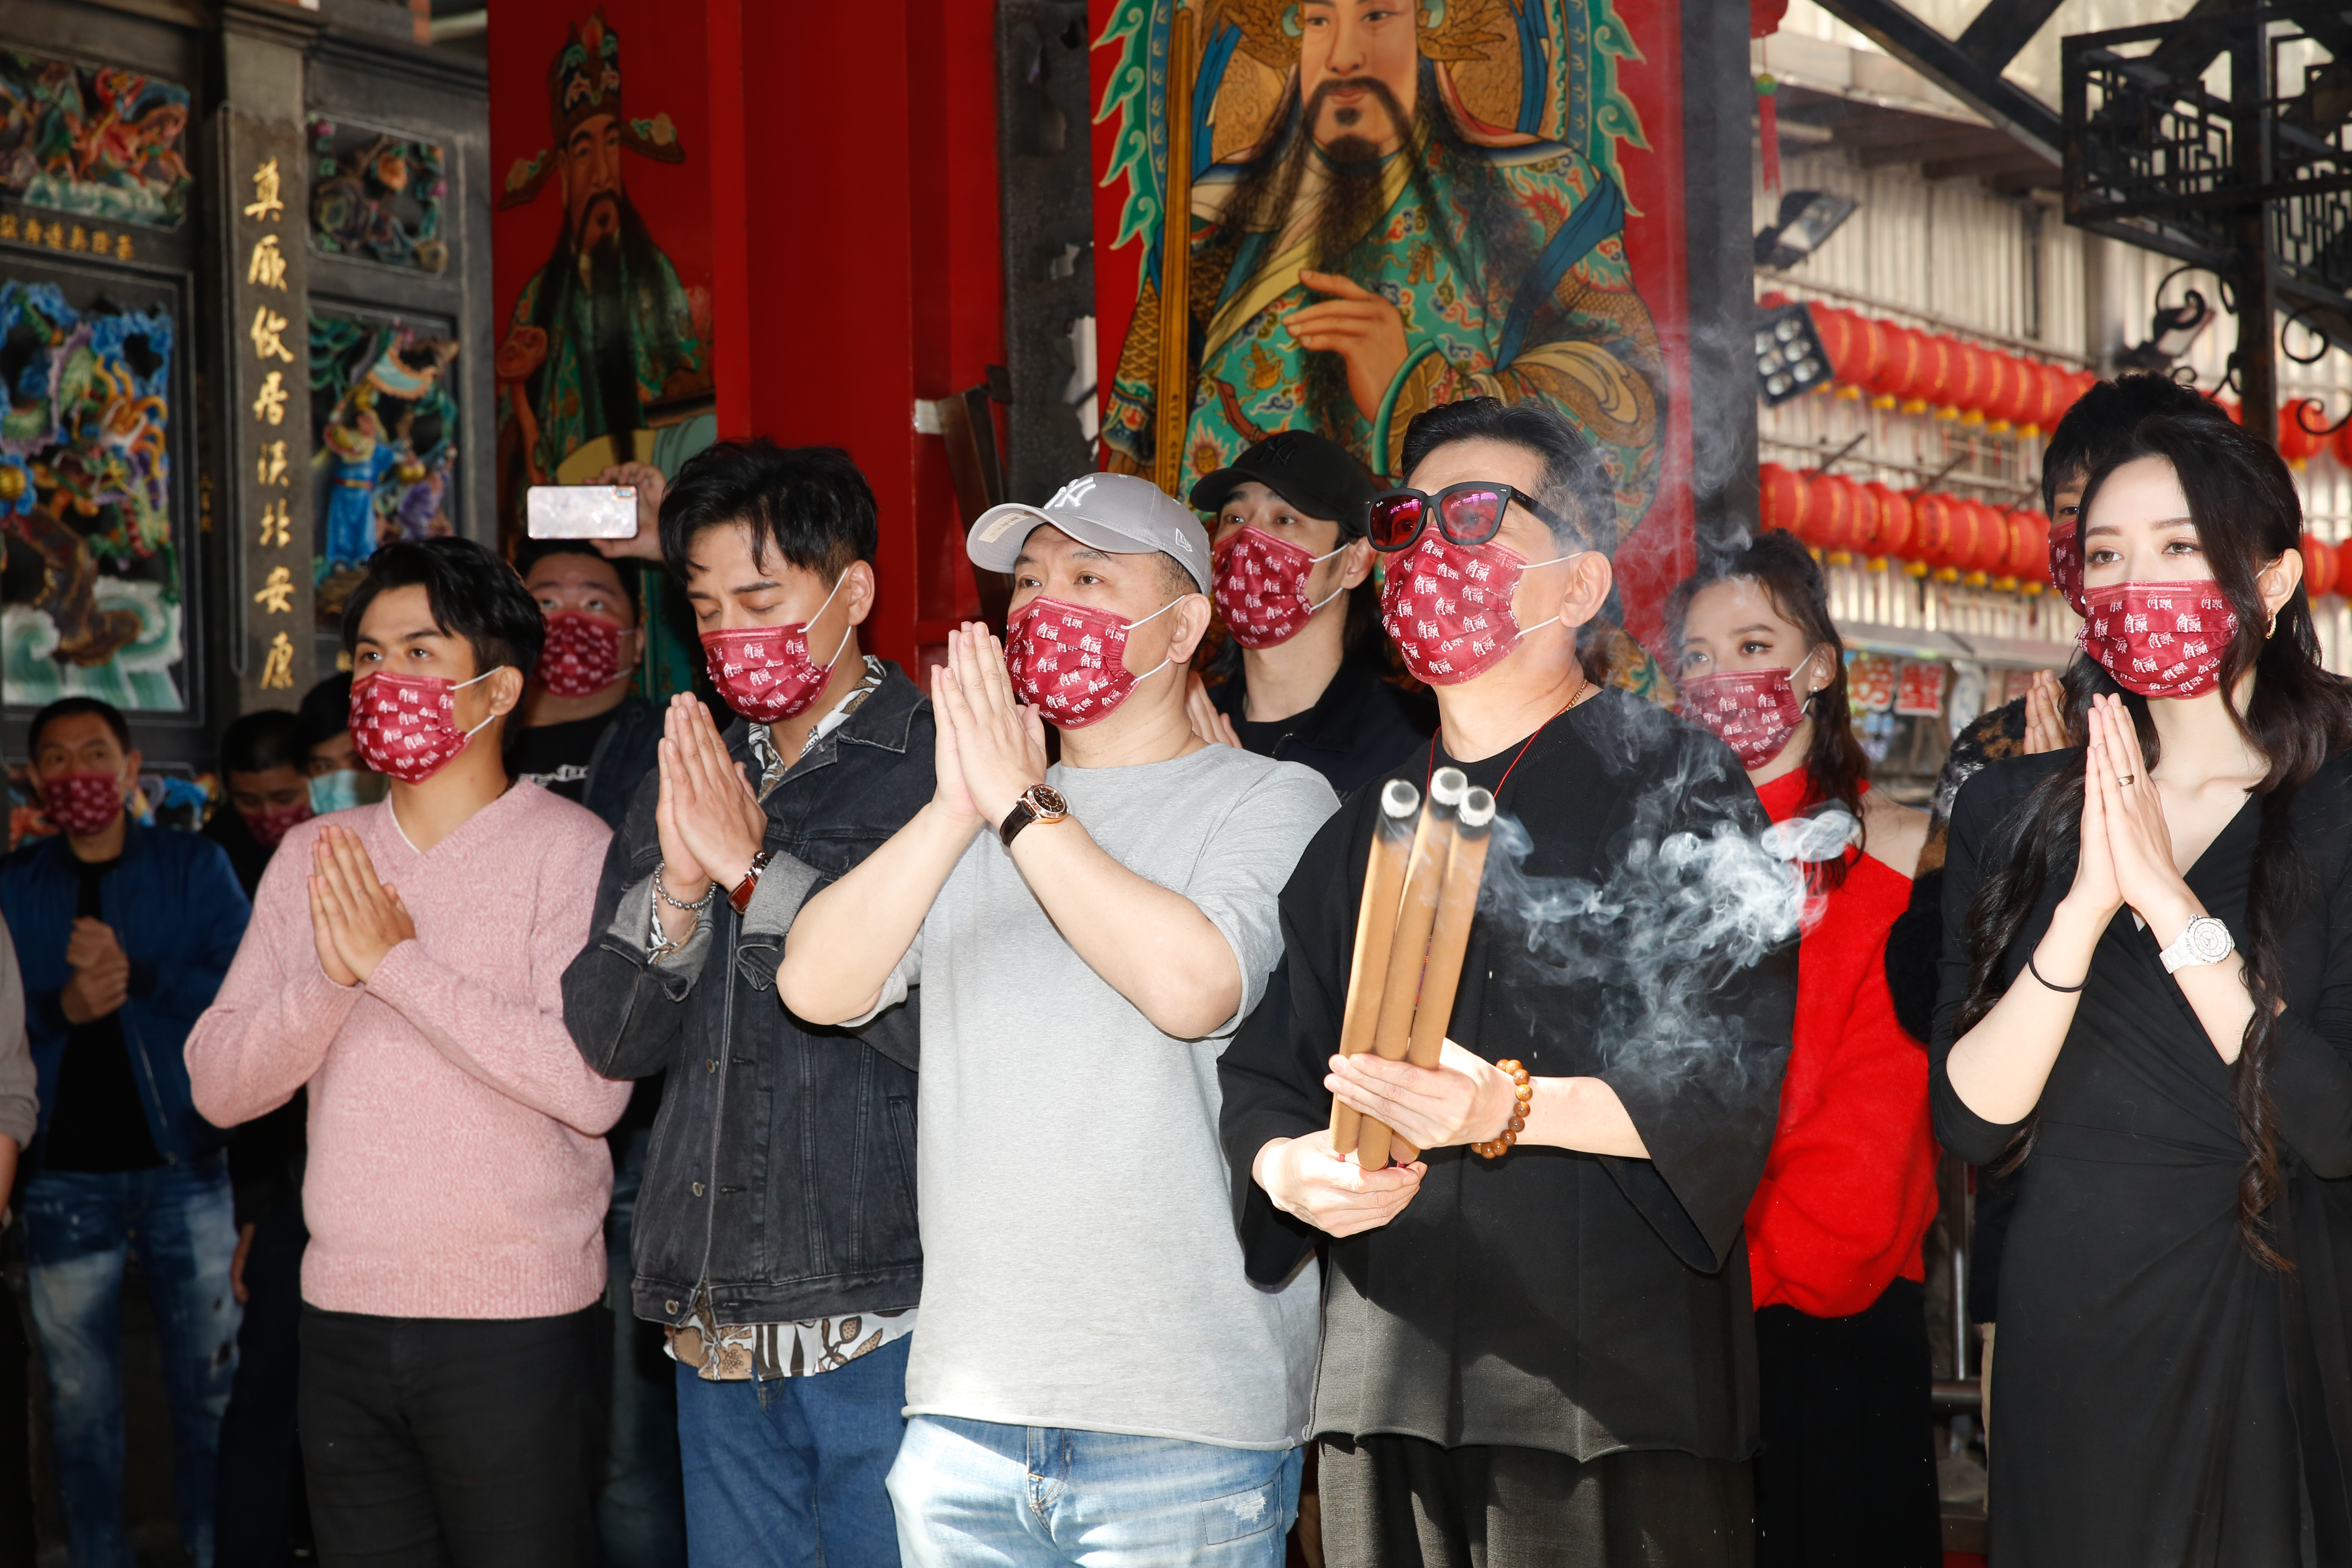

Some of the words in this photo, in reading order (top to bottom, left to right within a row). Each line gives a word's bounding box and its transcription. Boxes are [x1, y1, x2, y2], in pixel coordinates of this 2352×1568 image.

[1421, 539, 1444, 559] 角頭
[1466, 559, 1490, 581] 角頭
[1414, 575, 1437, 595] 角頭
[1462, 585, 1484, 604] 角頭
[1434, 597, 1457, 615] 角頭
[1036, 621, 1058, 641] 角頭
[1417, 620, 1440, 639] 角頭
[1463, 616, 1488, 633] 角頭
[2124, 612, 2148, 633] 角頭
[2176, 613, 2202, 633] 角頭
[1080, 634, 1102, 655] 角頭
[1473, 637, 1496, 657] 角頭
[2148, 632, 2174, 649] 角頭
[2183, 641, 2208, 659] 角頭
[1037, 657, 1058, 673] 角頭
[1080, 653, 1102, 669] 角頭
[1429, 660, 1454, 674] 角頭
[2132, 658, 2159, 673] 角頭
[1058, 669, 1082, 686] 角頭
[2162, 662, 2189, 681] 角頭
[1046, 694, 1069, 709] 角頭
